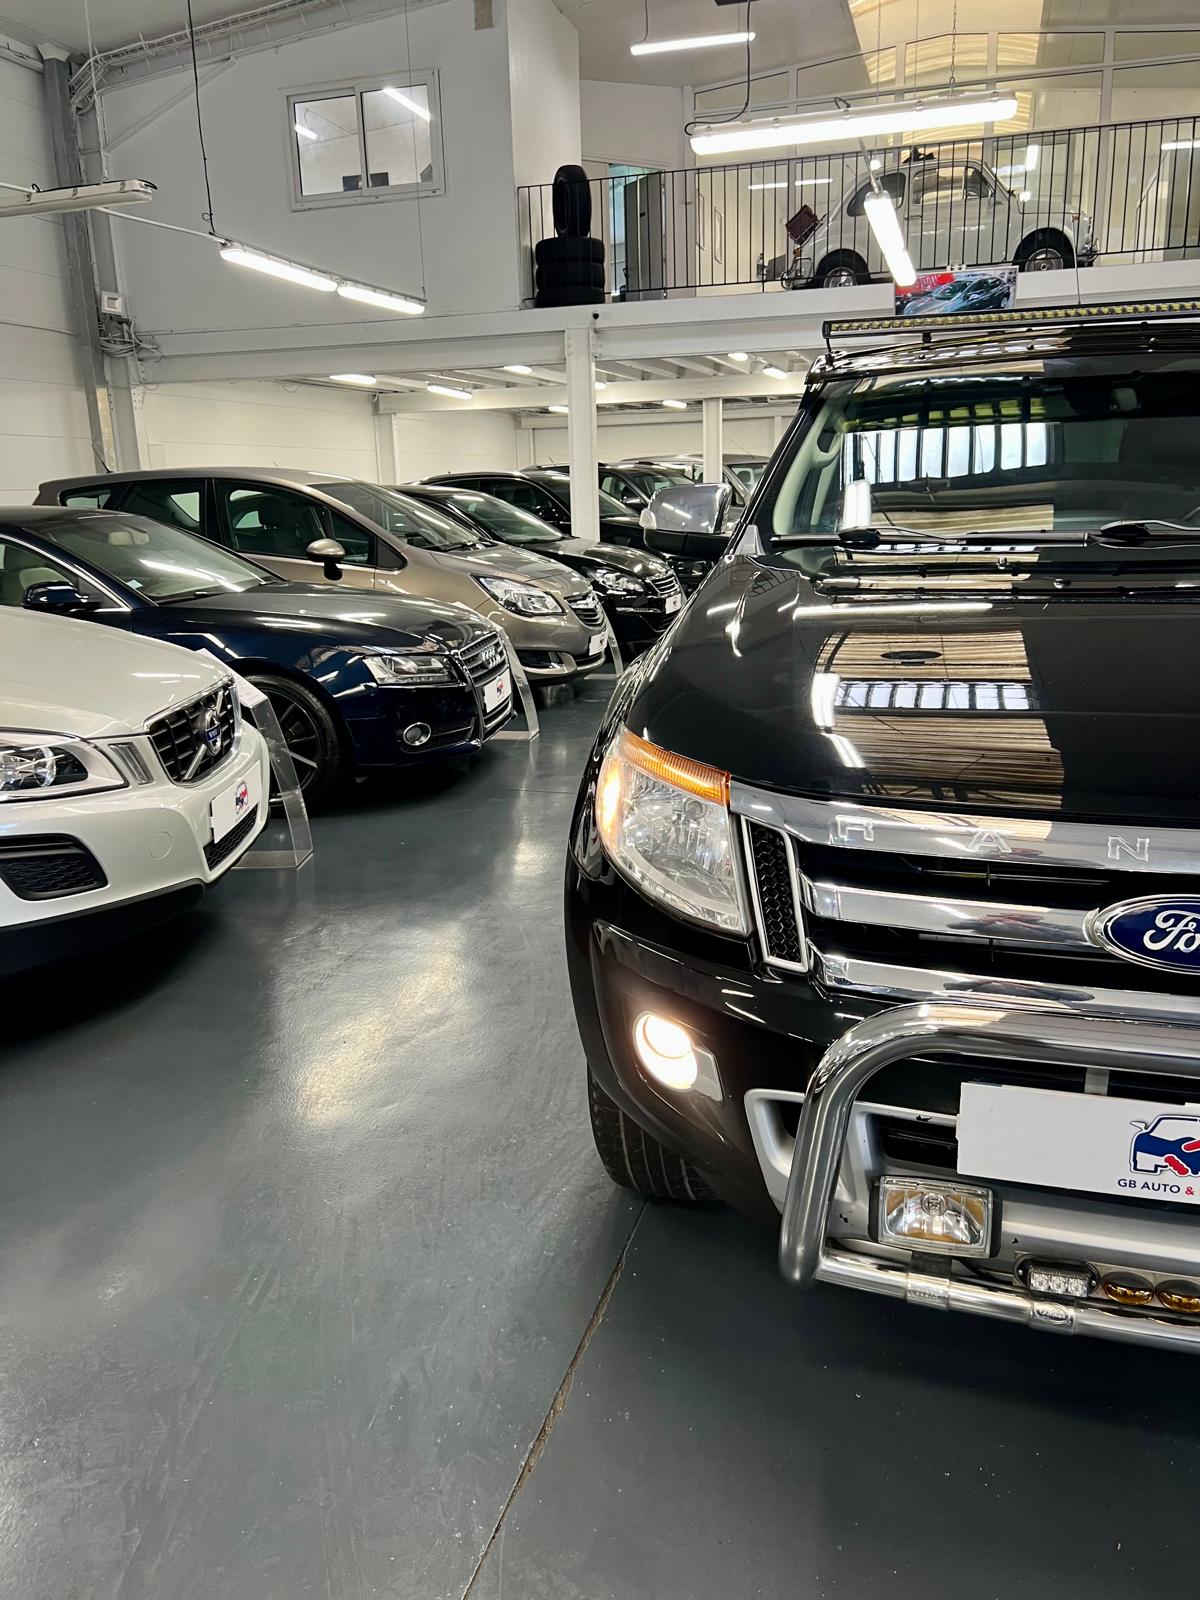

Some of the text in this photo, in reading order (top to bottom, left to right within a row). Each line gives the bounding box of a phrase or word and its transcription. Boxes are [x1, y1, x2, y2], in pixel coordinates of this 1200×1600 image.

[1117, 1178, 1195, 1196] GB AUTO &
